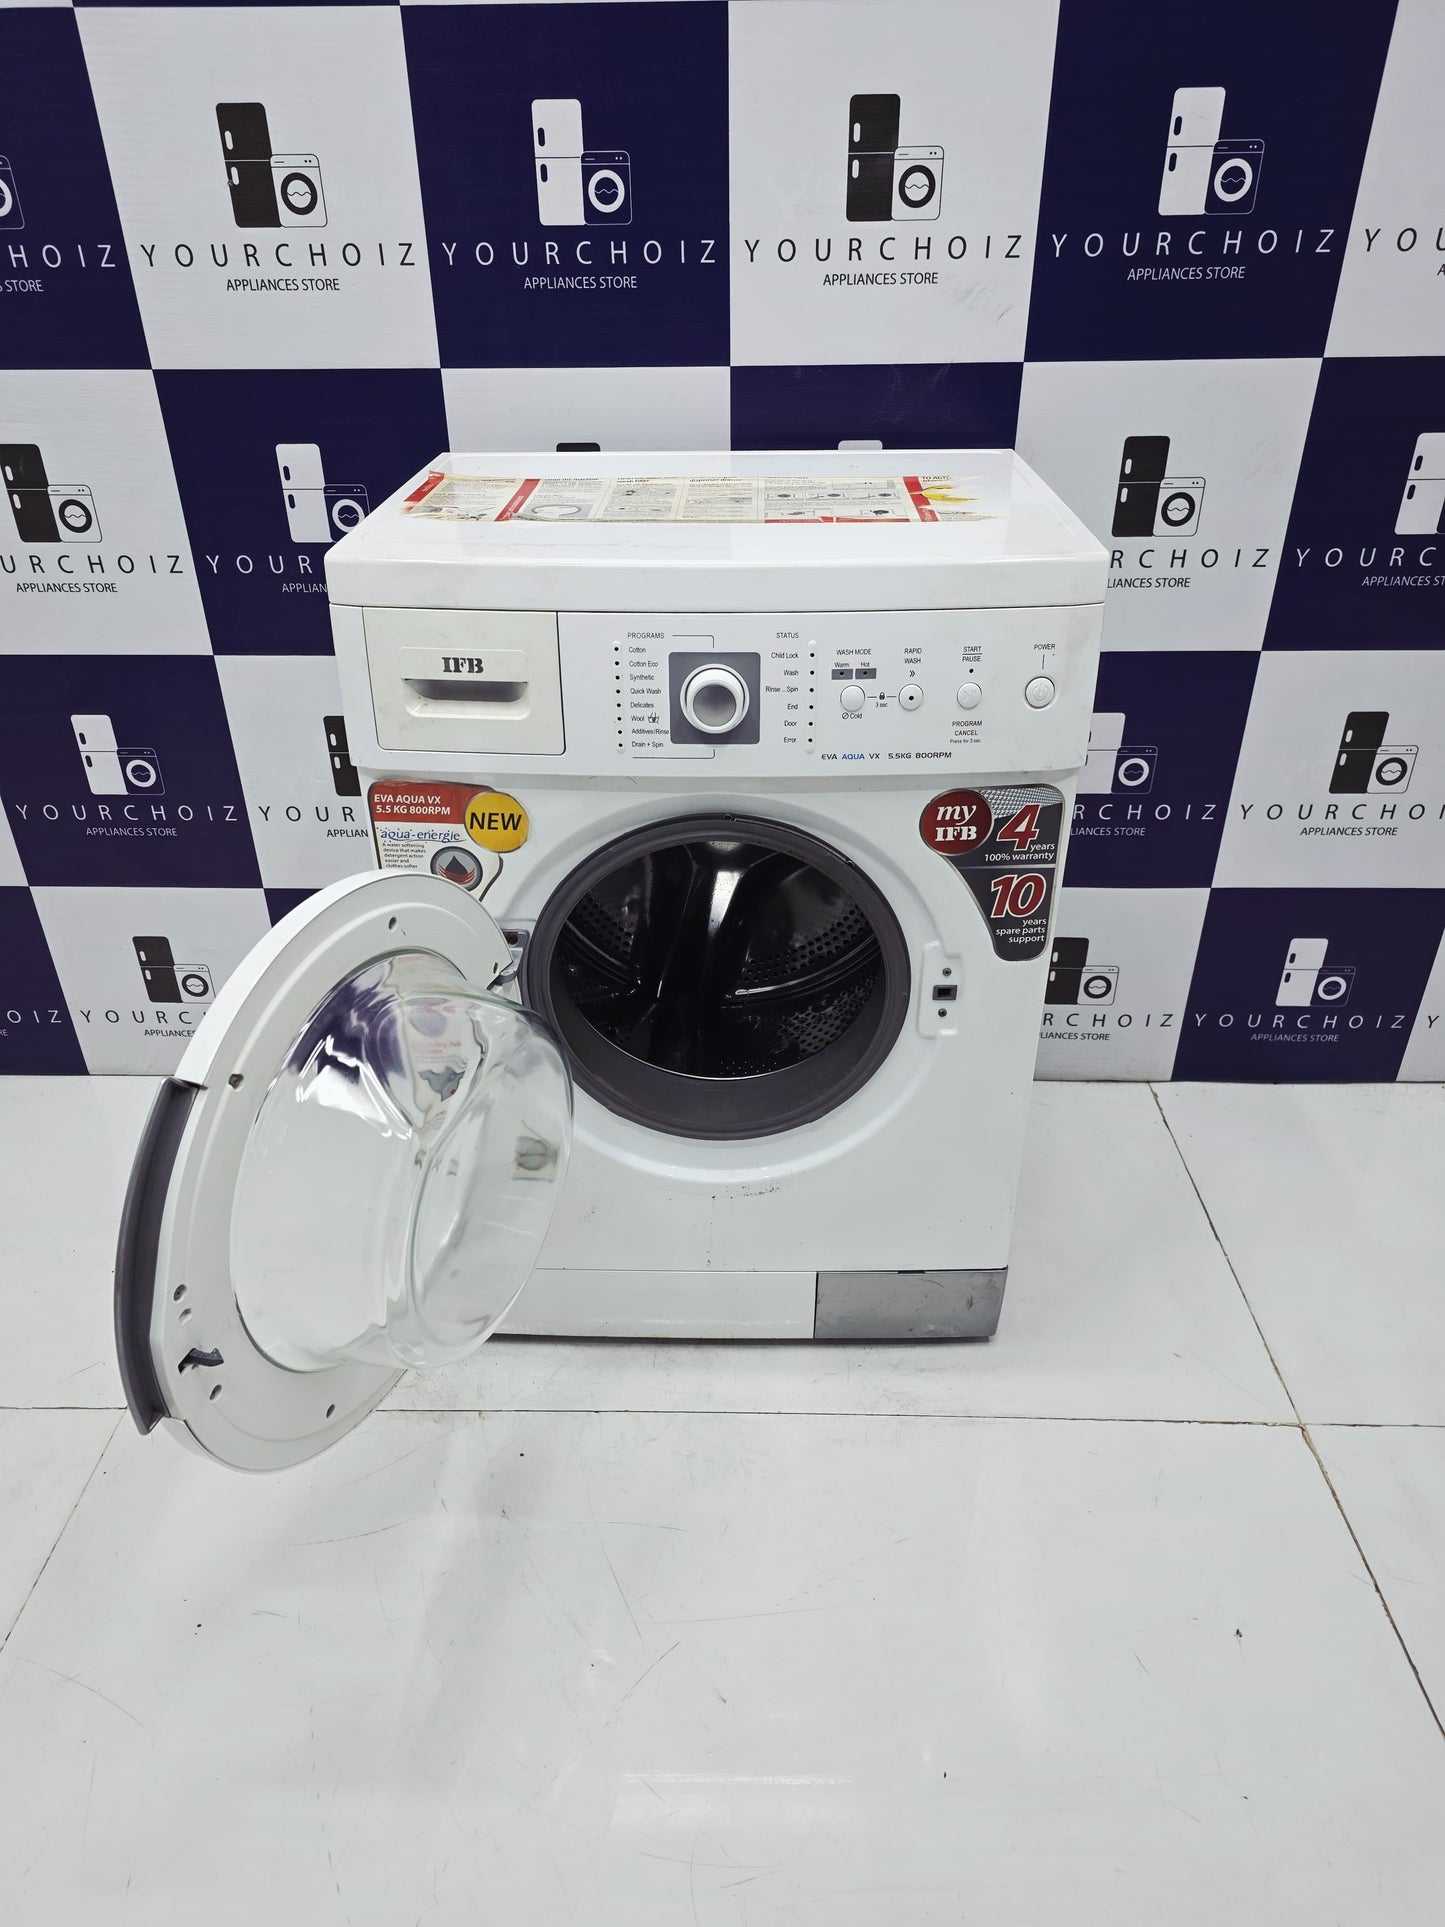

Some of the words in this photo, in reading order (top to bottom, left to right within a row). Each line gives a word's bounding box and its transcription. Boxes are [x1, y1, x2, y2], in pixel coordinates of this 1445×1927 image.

[1052, 229, 1335, 258] YOURCHOIZ
[442, 240, 716, 266] YOURCHOIZ
[744, 235, 1022, 263] YOURCHOIZ
[140, 243, 415, 268] YOURCHOIZ
[1127, 267, 1203, 281] APPLIANCES
[1205, 266, 1246, 280] STORE
[524, 276, 597, 289] APPLIANCES
[599, 276, 638, 289] STORE
[823, 273, 897, 286] APPLIANCES
[899, 272, 939, 285] STORE
[4, 279, 44, 292] STORE
[226, 278, 299, 291] APPLIANCES
[301, 278, 340, 291] STORE
[1154, 577, 1191, 588] STORE
[1361, 576, 1432, 587] APPLIANCES
[16, 583, 81, 593] APPLIANCES
[82, 583, 118, 593] STORE
[627, 632, 665, 640] PROGRAMS
[963, 645, 982, 653] START
[441, 656, 484, 674] IFB
[629, 673, 655, 682] Synthetic
[630, 687, 645, 695] Quick
[765, 685, 781, 693] Rinse
[786, 685, 799, 693] Spin
[630, 701, 655, 709] Delicates
[784, 719, 798, 727] Door
[651, 741, 664, 749] Spin
[783, 736, 797, 744] Error
[887, 752, 912, 760] 5.5KG
[915, 751, 952, 759] 800RPM
[374, 794, 394, 803] EVA
[395, 794, 426, 805] AQUA
[427, 795, 441, 804] VX
[16, 804, 238, 821] YOURCHOIZ
[376, 805, 392, 814] 5.5
[393, 805, 408, 814] KG
[409, 806, 451, 815] 800RPM
[936, 804, 977, 826] my
[469, 812, 523, 831] NEW
[86, 827, 145, 836] APPLIANCES
[146, 827, 178, 837] STORE
[996, 803, 1042, 851] 4
[1113, 827, 1146, 836] STORE
[1299, 827, 1363, 836] APPLIANCES
[1365, 827, 1399, 836] STORE
[934, 825, 978, 842] IFB
[1030, 843, 1055, 853] years
[984, 853, 1011, 862] 100%
[1012, 852, 1055, 861] warranty
[990, 873, 1047, 919] 10
[1022, 918, 1047, 927] years
[995, 927, 1021, 936] spare
[1022, 926, 1046, 936] parts
[1008, 935, 1045, 945] support
[80, 1010, 206, 1025] YOURC
[1195, 1013, 1406, 1029] YOURCHOIZ
[1080, 1032, 1110, 1041] STORE
[1250, 1033, 1308, 1042] APPLIANCES
[1309, 1034, 1341, 1042] STORE
